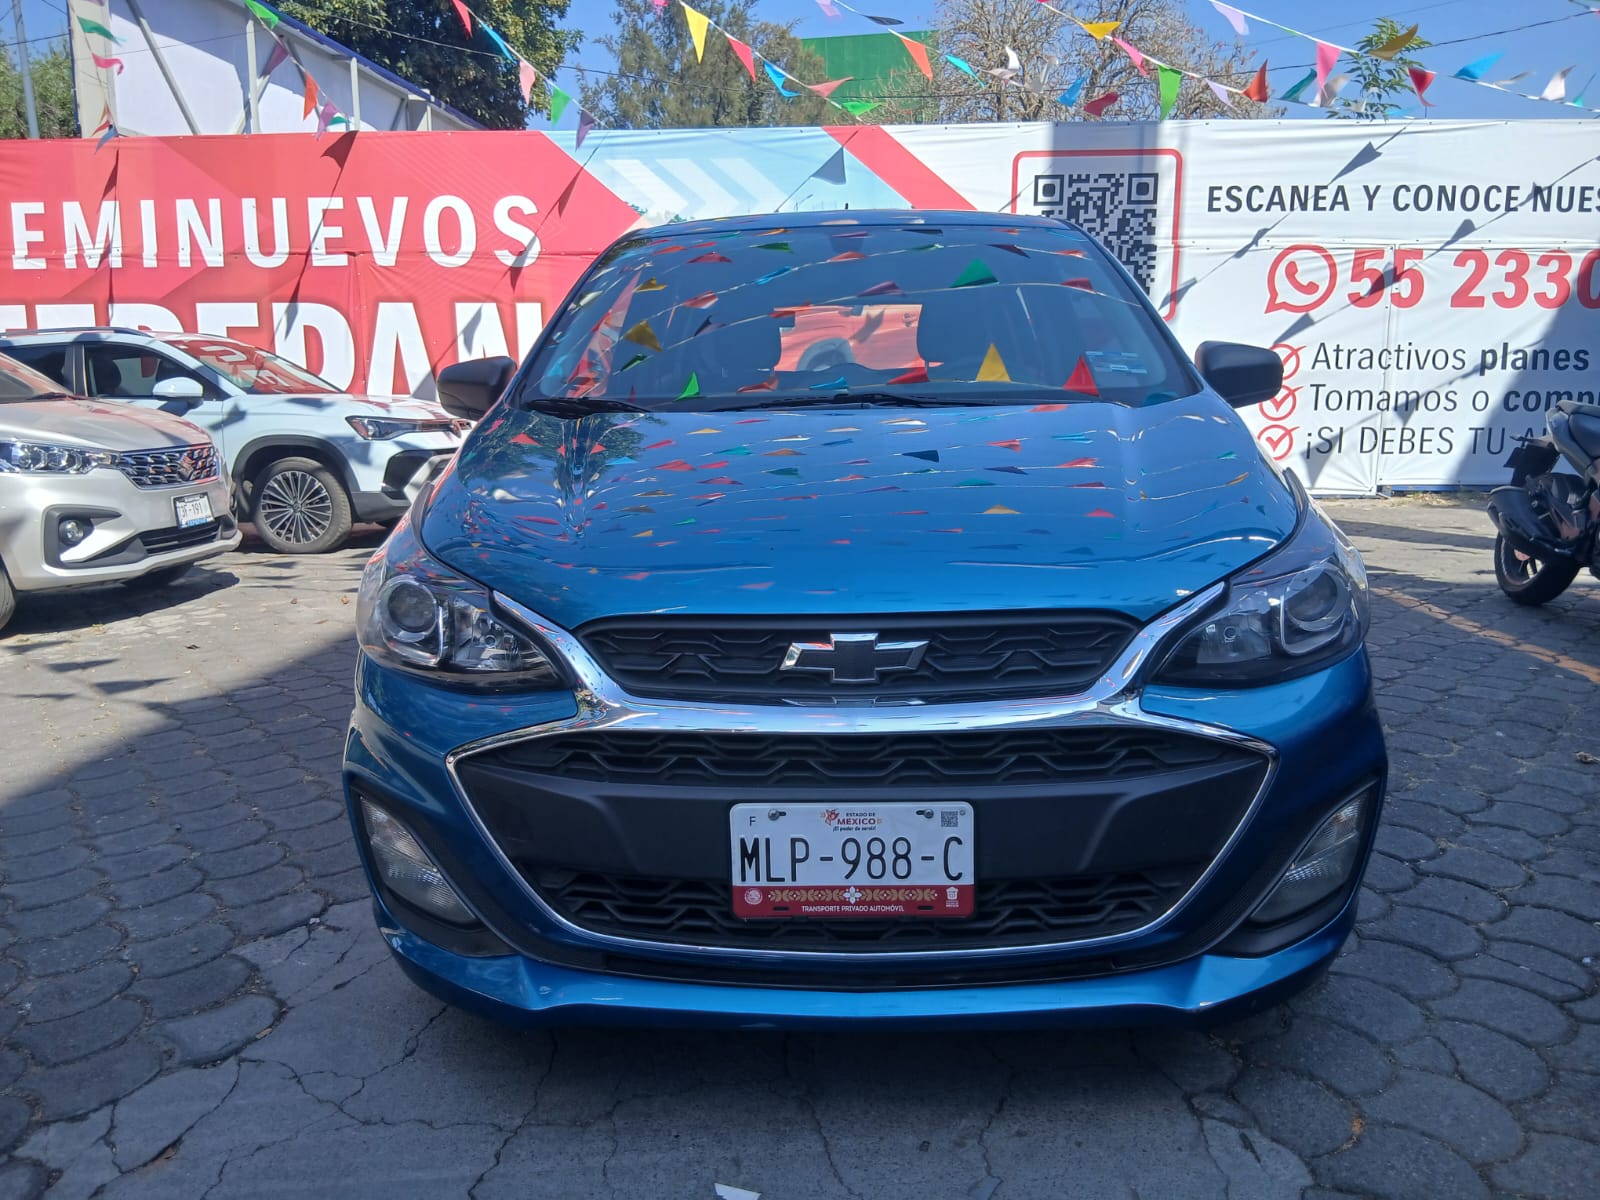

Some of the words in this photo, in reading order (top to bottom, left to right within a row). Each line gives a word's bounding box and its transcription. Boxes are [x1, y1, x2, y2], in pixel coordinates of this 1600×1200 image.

[1207, 184, 1350, 212] ESCANEA
[1362, 185, 1381, 211] Y
[1393, 184, 1520, 212] CONOCE
[1347, 248, 1424, 309] 55
[1311, 342, 1466, 371] Atractivos
[1480, 342, 1589, 376] planes
[1310, 384, 1457, 412] Tomamos
[1472, 390, 1488, 412] o
[1306, 427, 1343, 459] ¡SI
[1359, 426, 1454, 455] DEBES
[1469, 427, 1506, 455] TU
[739, 836, 963, 883] MLP-988-C
